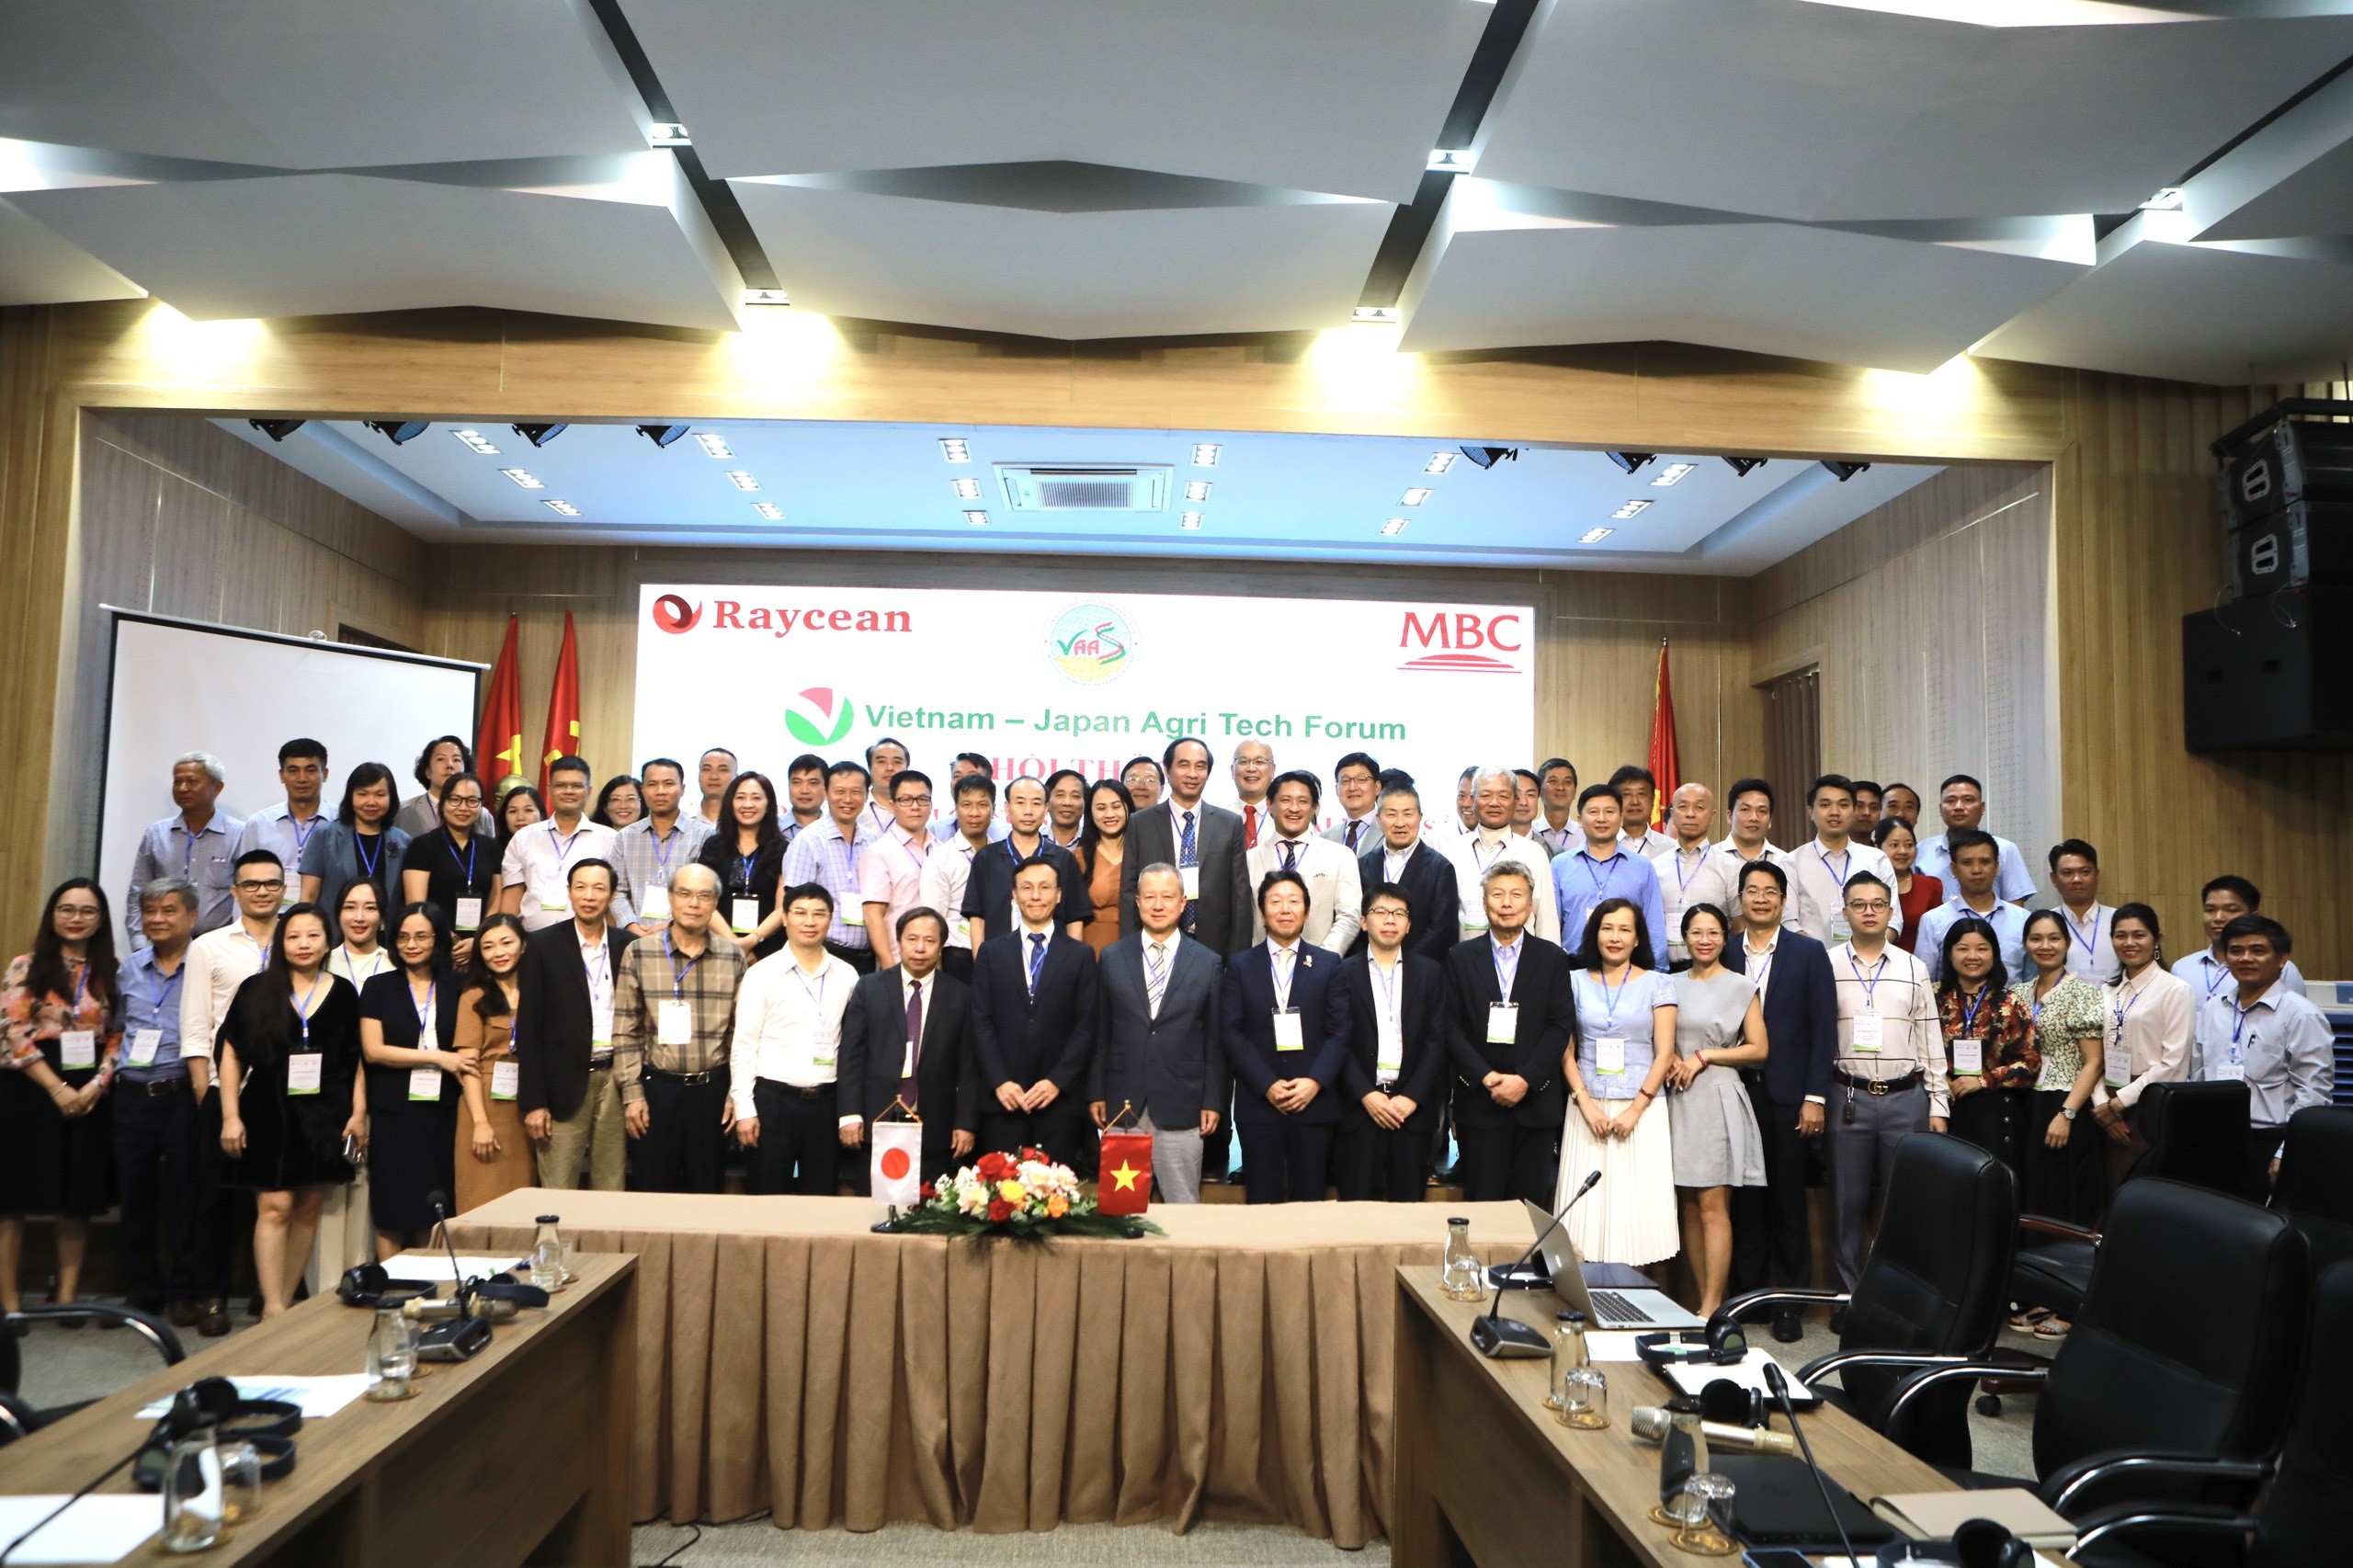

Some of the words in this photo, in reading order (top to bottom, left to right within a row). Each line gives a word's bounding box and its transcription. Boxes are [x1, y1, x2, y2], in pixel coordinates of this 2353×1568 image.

[712, 600, 913, 639] Raycean
[1399, 611, 1522, 653] MBC
[865, 704, 995, 731] Vietnam
[1034, 709, 1131, 736] Japan
[1140, 710, 1207, 740] Agri
[1218, 712, 1292, 736] Tech
[1305, 714, 1407, 740] Forum
